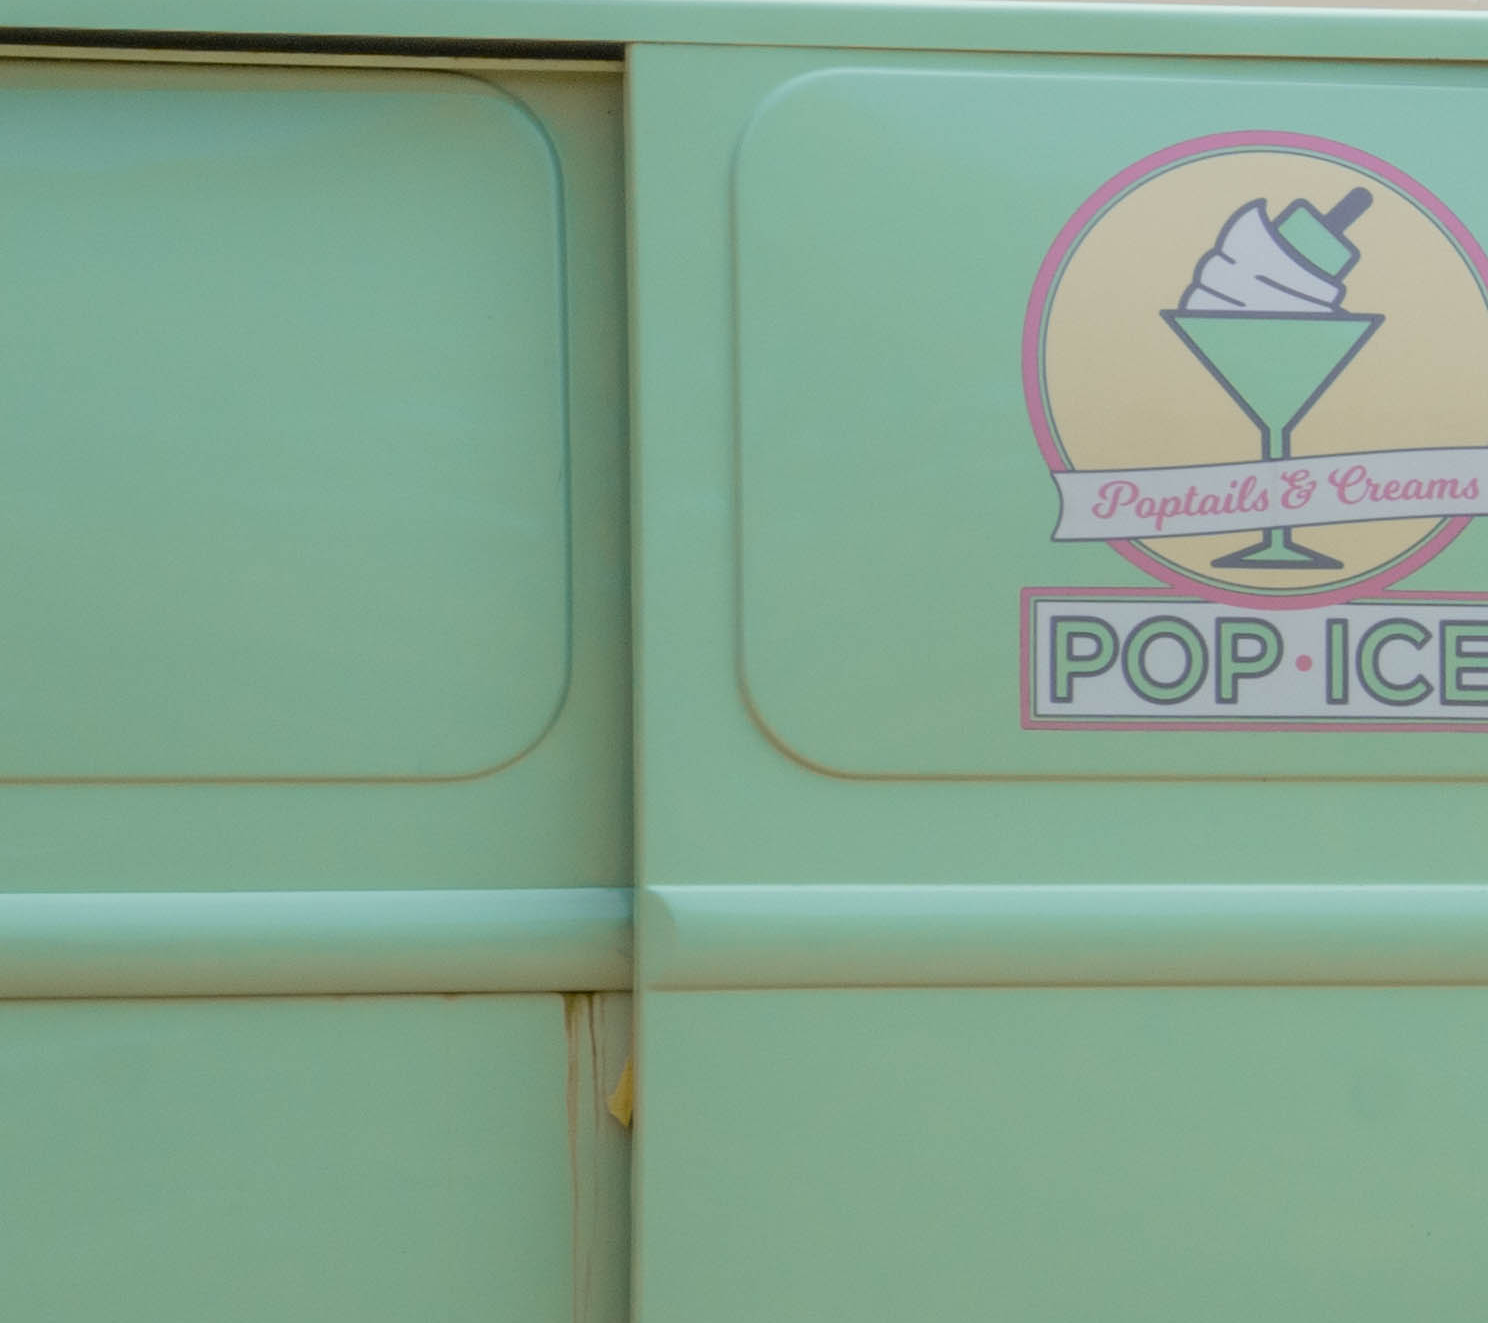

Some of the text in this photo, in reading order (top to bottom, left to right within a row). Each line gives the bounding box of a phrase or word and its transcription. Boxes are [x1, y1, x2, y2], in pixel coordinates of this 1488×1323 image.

[1090, 465, 1480, 530] Poptails & Creams
[1050, 614, 1285, 706] POP
